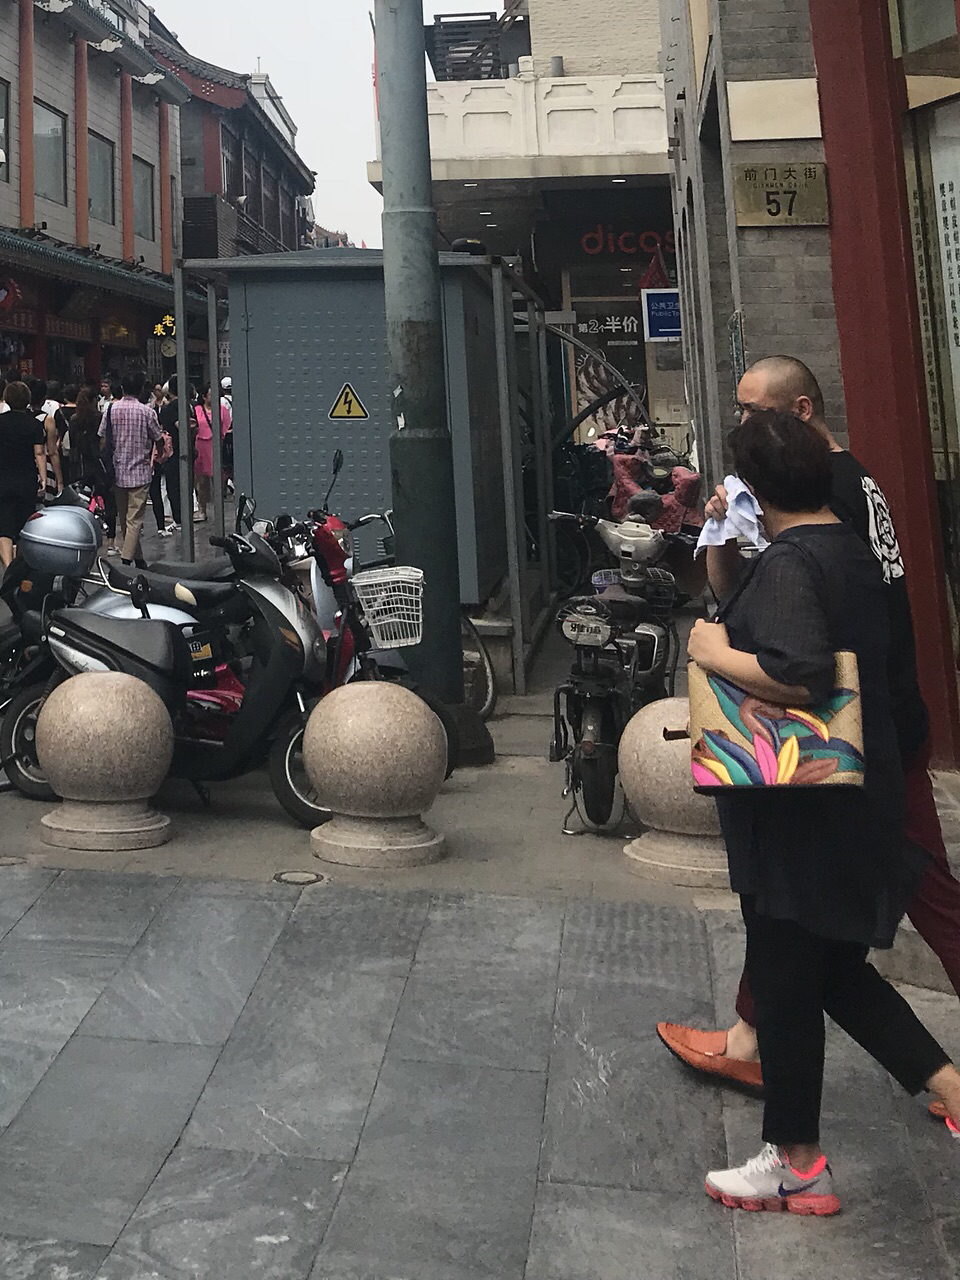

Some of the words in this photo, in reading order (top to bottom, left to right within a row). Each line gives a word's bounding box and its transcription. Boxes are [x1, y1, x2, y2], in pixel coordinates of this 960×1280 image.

[744, 166, 817, 181] 前门大街
[765, 190, 797, 217] 57
[161, 314, 175, 327] 老
[578, 315, 639, 334] 第2个半价
